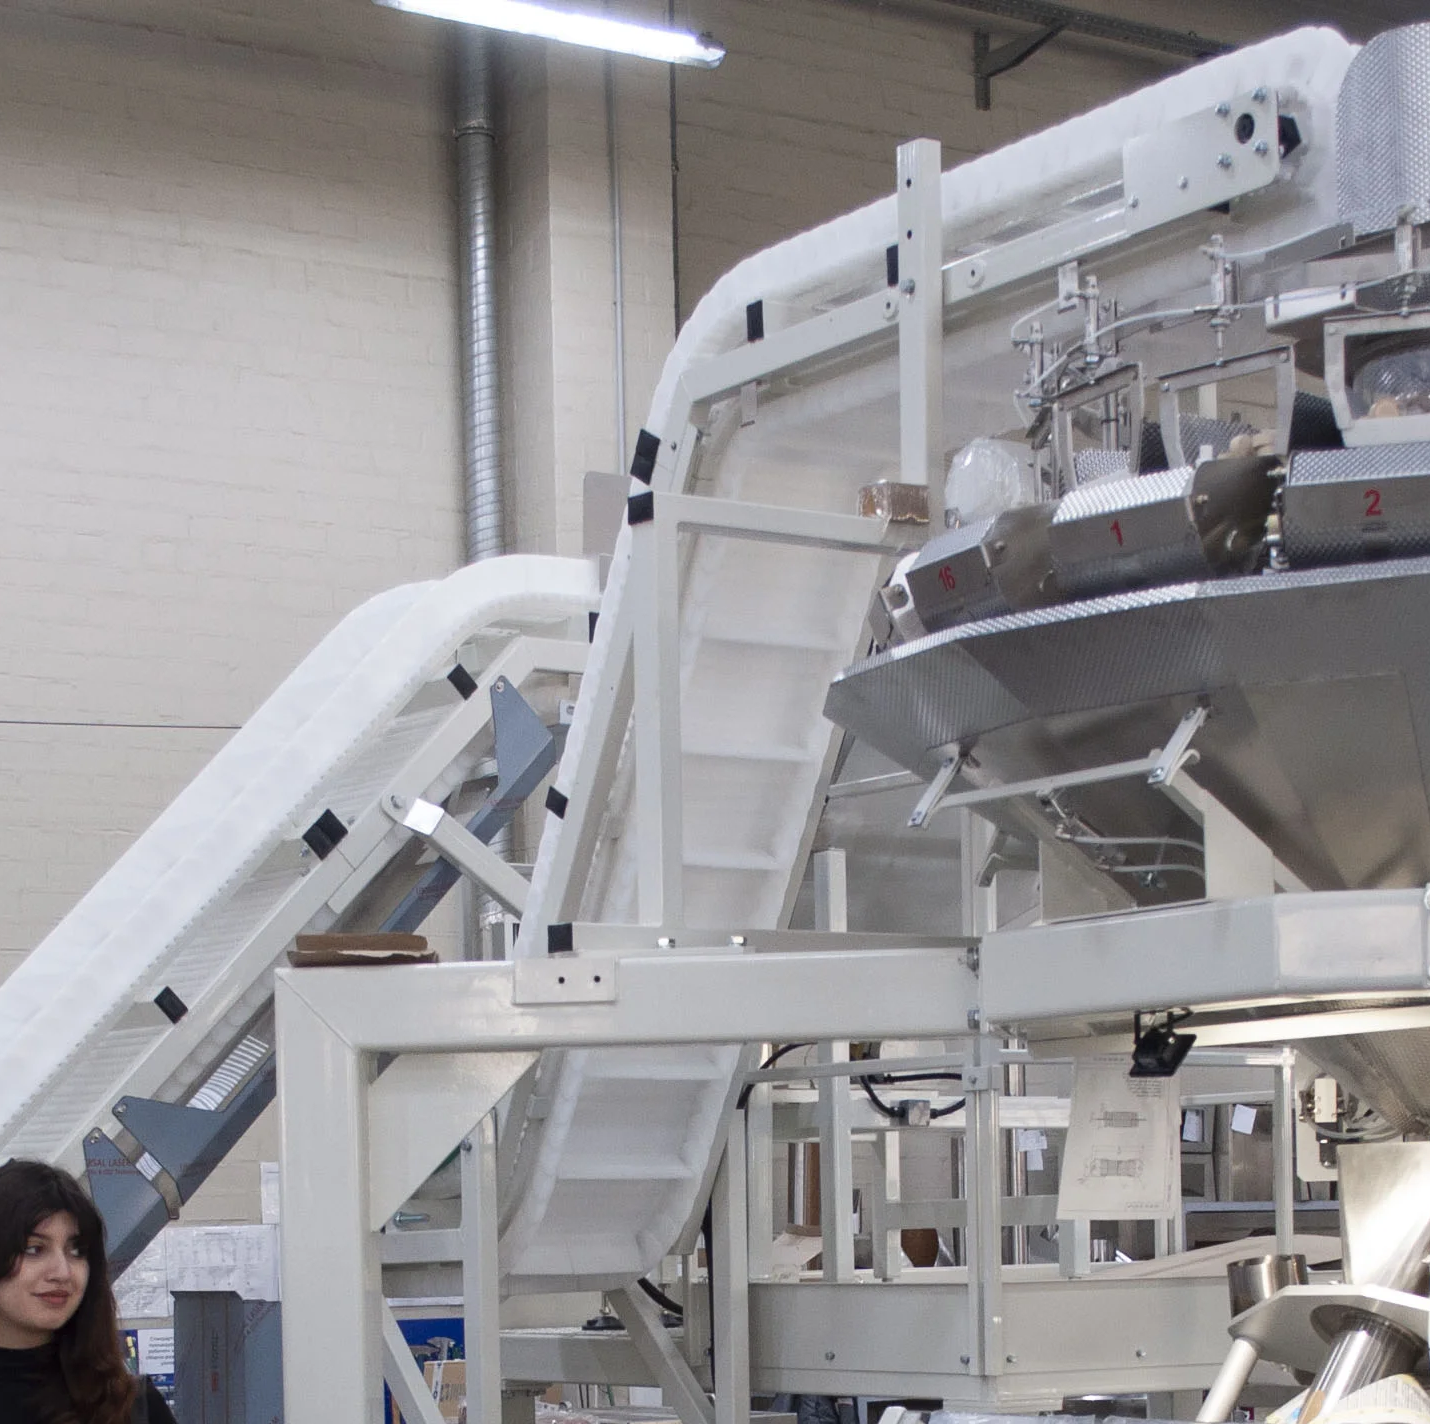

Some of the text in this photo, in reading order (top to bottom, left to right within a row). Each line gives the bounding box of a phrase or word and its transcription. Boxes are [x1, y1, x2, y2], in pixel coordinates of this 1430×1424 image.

[1362, 489, 1383, 517] 2
[1109, 518, 1123, 547] 1
[938, 563, 957, 592] 16
